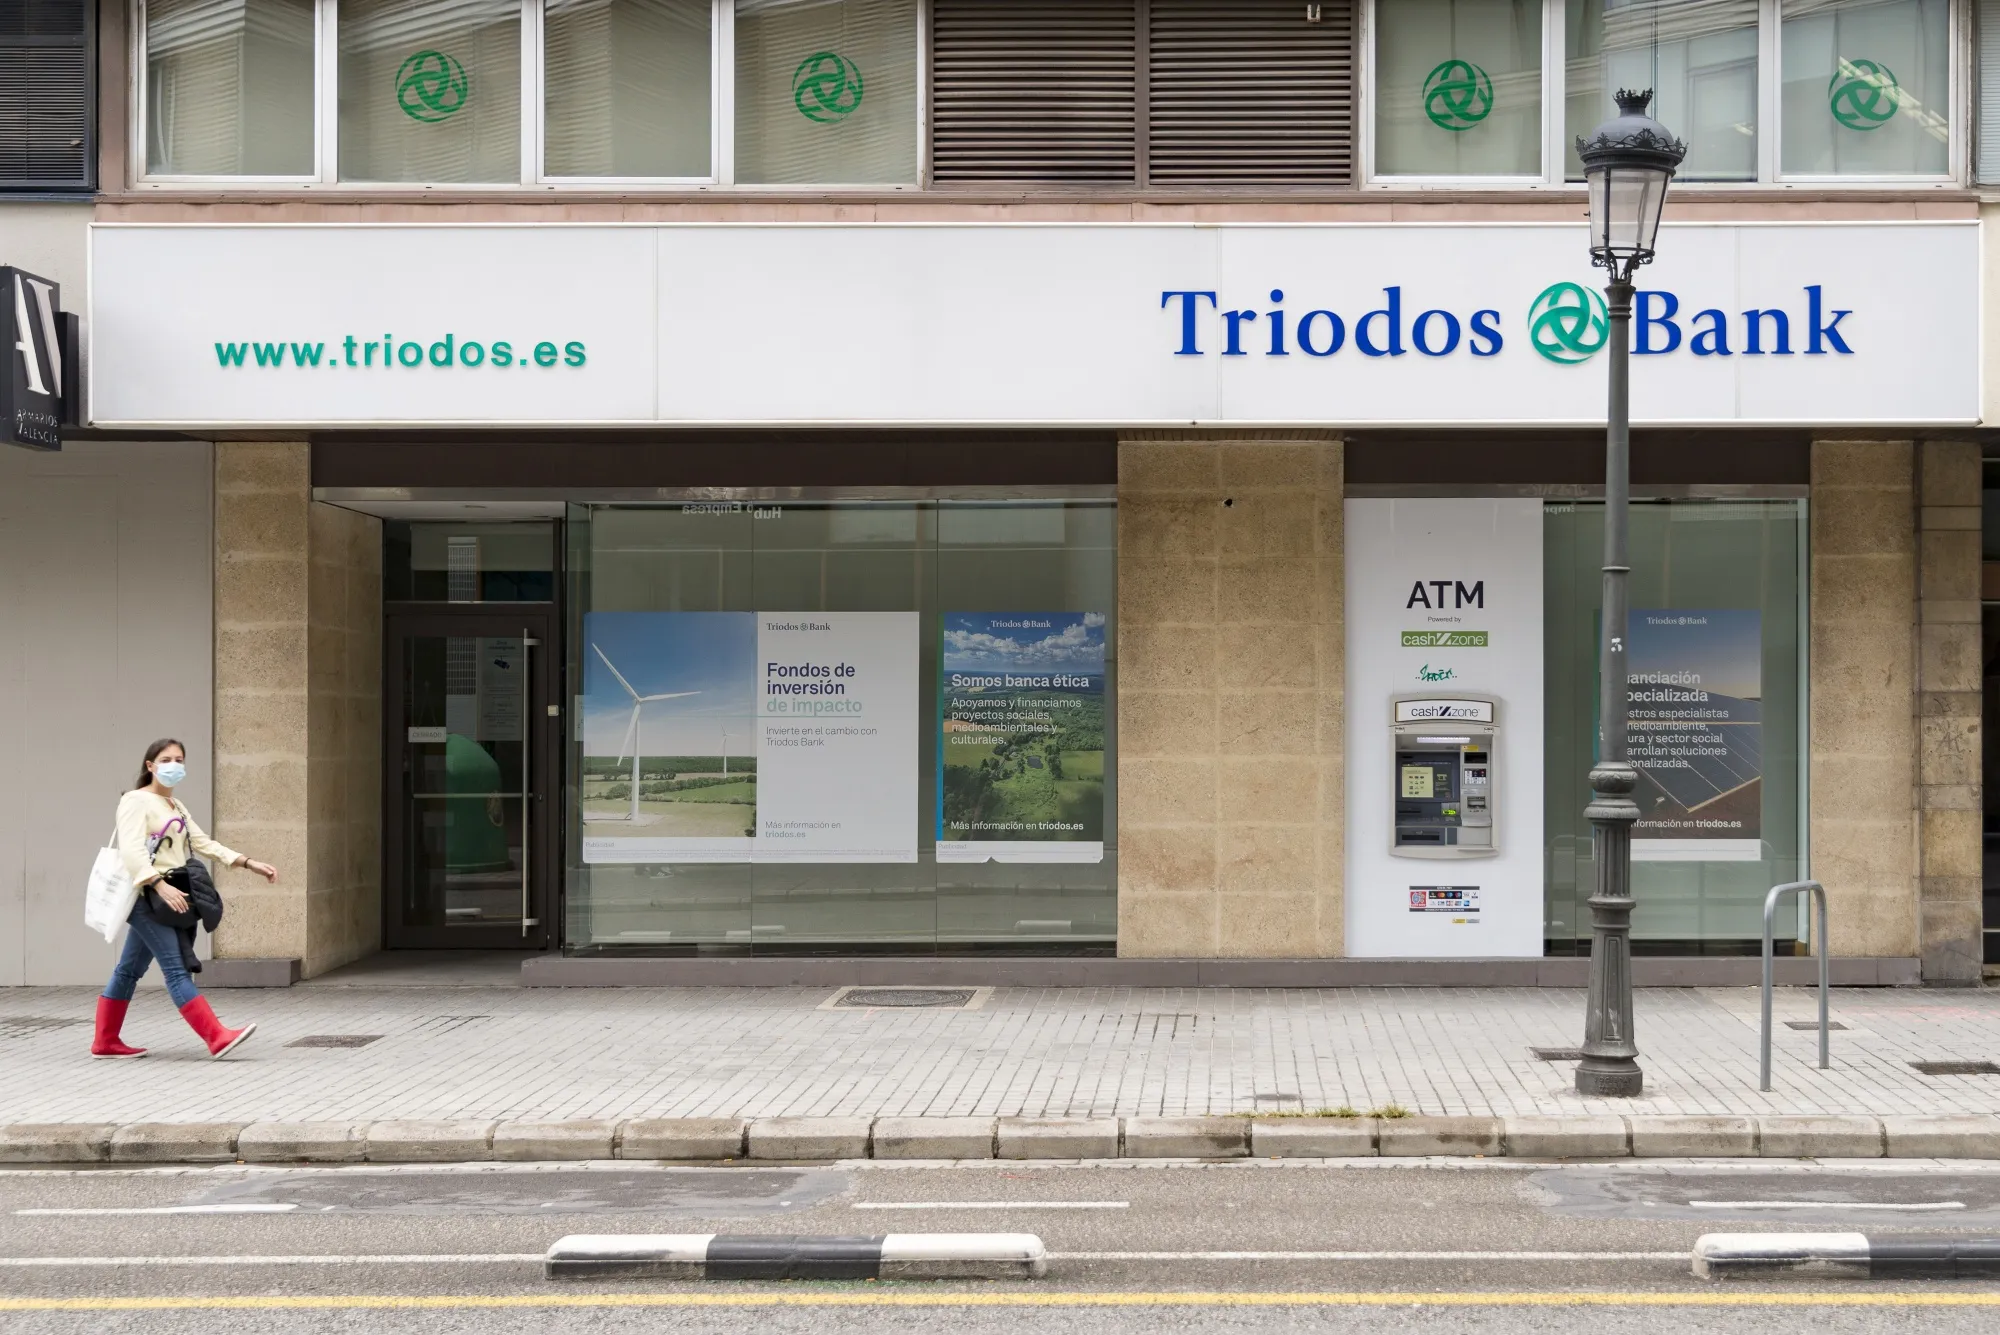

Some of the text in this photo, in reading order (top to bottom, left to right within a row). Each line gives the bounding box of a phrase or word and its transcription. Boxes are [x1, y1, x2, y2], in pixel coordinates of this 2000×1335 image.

[1161, 285, 1855, 358] Triodos Bank
[214, 333, 587, 367] www.triodos.es
[1406, 580, 1484, 609] ATM
[990, 619, 1052, 628] Triodos Bank
[1646, 616, 1708, 625] Triodos Bank
[766, 622, 831, 631] Triodos Bank
[767, 662, 856, 677] Fondos de
[951, 673, 1089, 688] Somos banca ética
[1626, 671, 1701, 684] anciación
[767, 679, 845, 695] inversión
[1626, 688, 1709, 702] pecializada
[766, 698, 863, 717] de impacto
[951, 697, 1082, 709] Apoyamos y financiamos
[951, 710, 1053, 721] proyectos sociales,
[1658, 708, 1729, 721] especialistas
[766, 726, 800, 735] Invierte
[814, 726, 824, 735] el
[825, 726, 859, 735] cambio
[951, 723, 1058, 734] medioambientales y
[766, 737, 825, 747] Triodos Bank
[951, 735, 1007, 744] culturales.
[1647, 735, 1653, 745] y
[1655, 734, 1690, 743] sector
[1691, 733, 1723, 743] social
[1626, 746, 1727, 755] arrollan soluciones
[765, 821, 783, 829] Más
[783, 820, 830, 829] información
[951, 821, 970, 830] Más
[971, 820, 1024, 830] información
[1038, 820, 1084, 830] triodos.es
[1696, 819, 1742, 828] triodos.es
[765, 830, 807, 838] triodos.es
